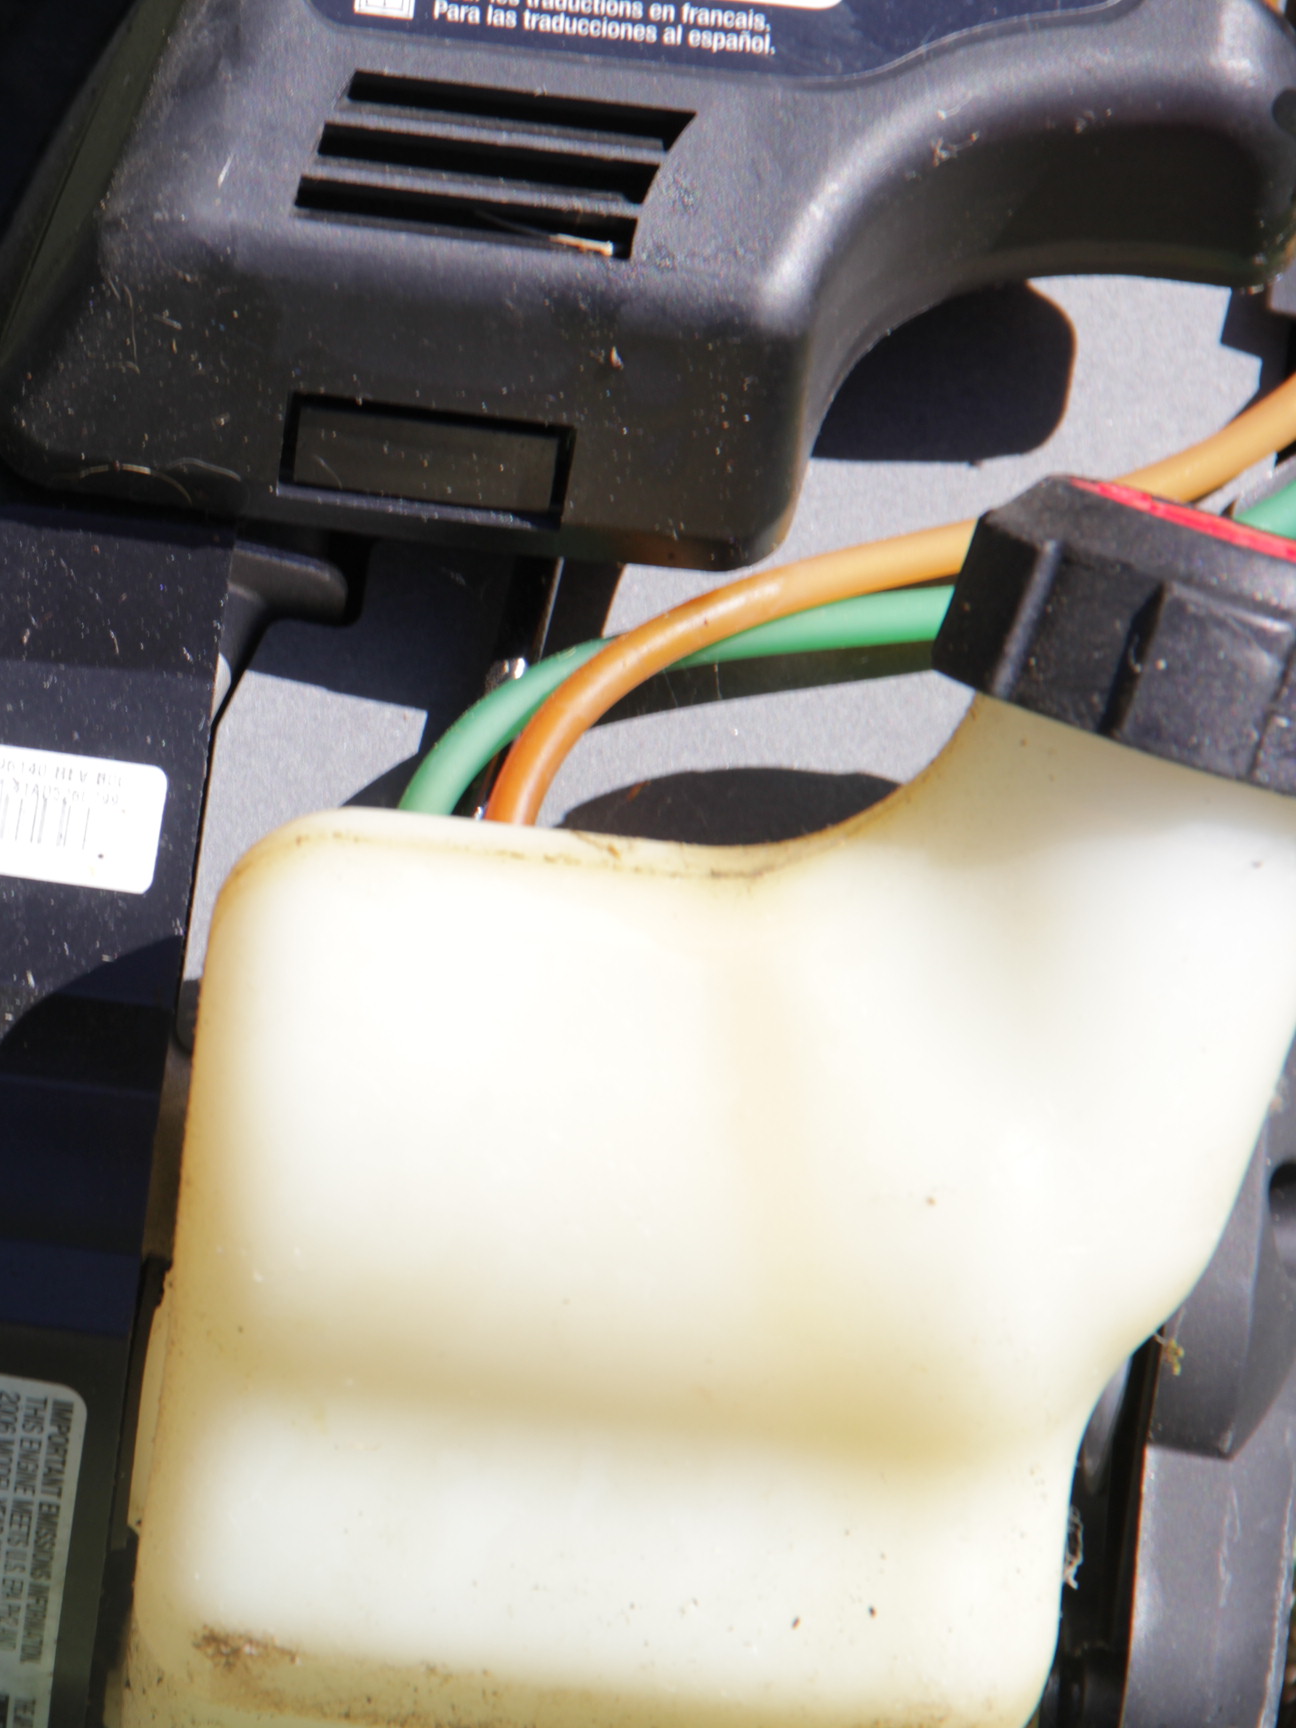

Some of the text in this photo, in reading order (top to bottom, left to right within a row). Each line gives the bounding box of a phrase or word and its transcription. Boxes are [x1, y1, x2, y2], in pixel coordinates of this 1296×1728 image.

[433, 0, 481, 24] Para
[486, 4, 517, 28] las
[522, 9, 658, 43] traducciones
[662, 25, 683, 46] al
[648, 3, 675, 22] en
[21, 1394, 47, 1435] THIS
[14, 1437, 42, 1496] ENGINE
[40, 1399, 74, 1498] IMPORTANT
[7, 1497, 34, 1549] MEETS
[30, 1501, 60, 1581] EMISSIONS
